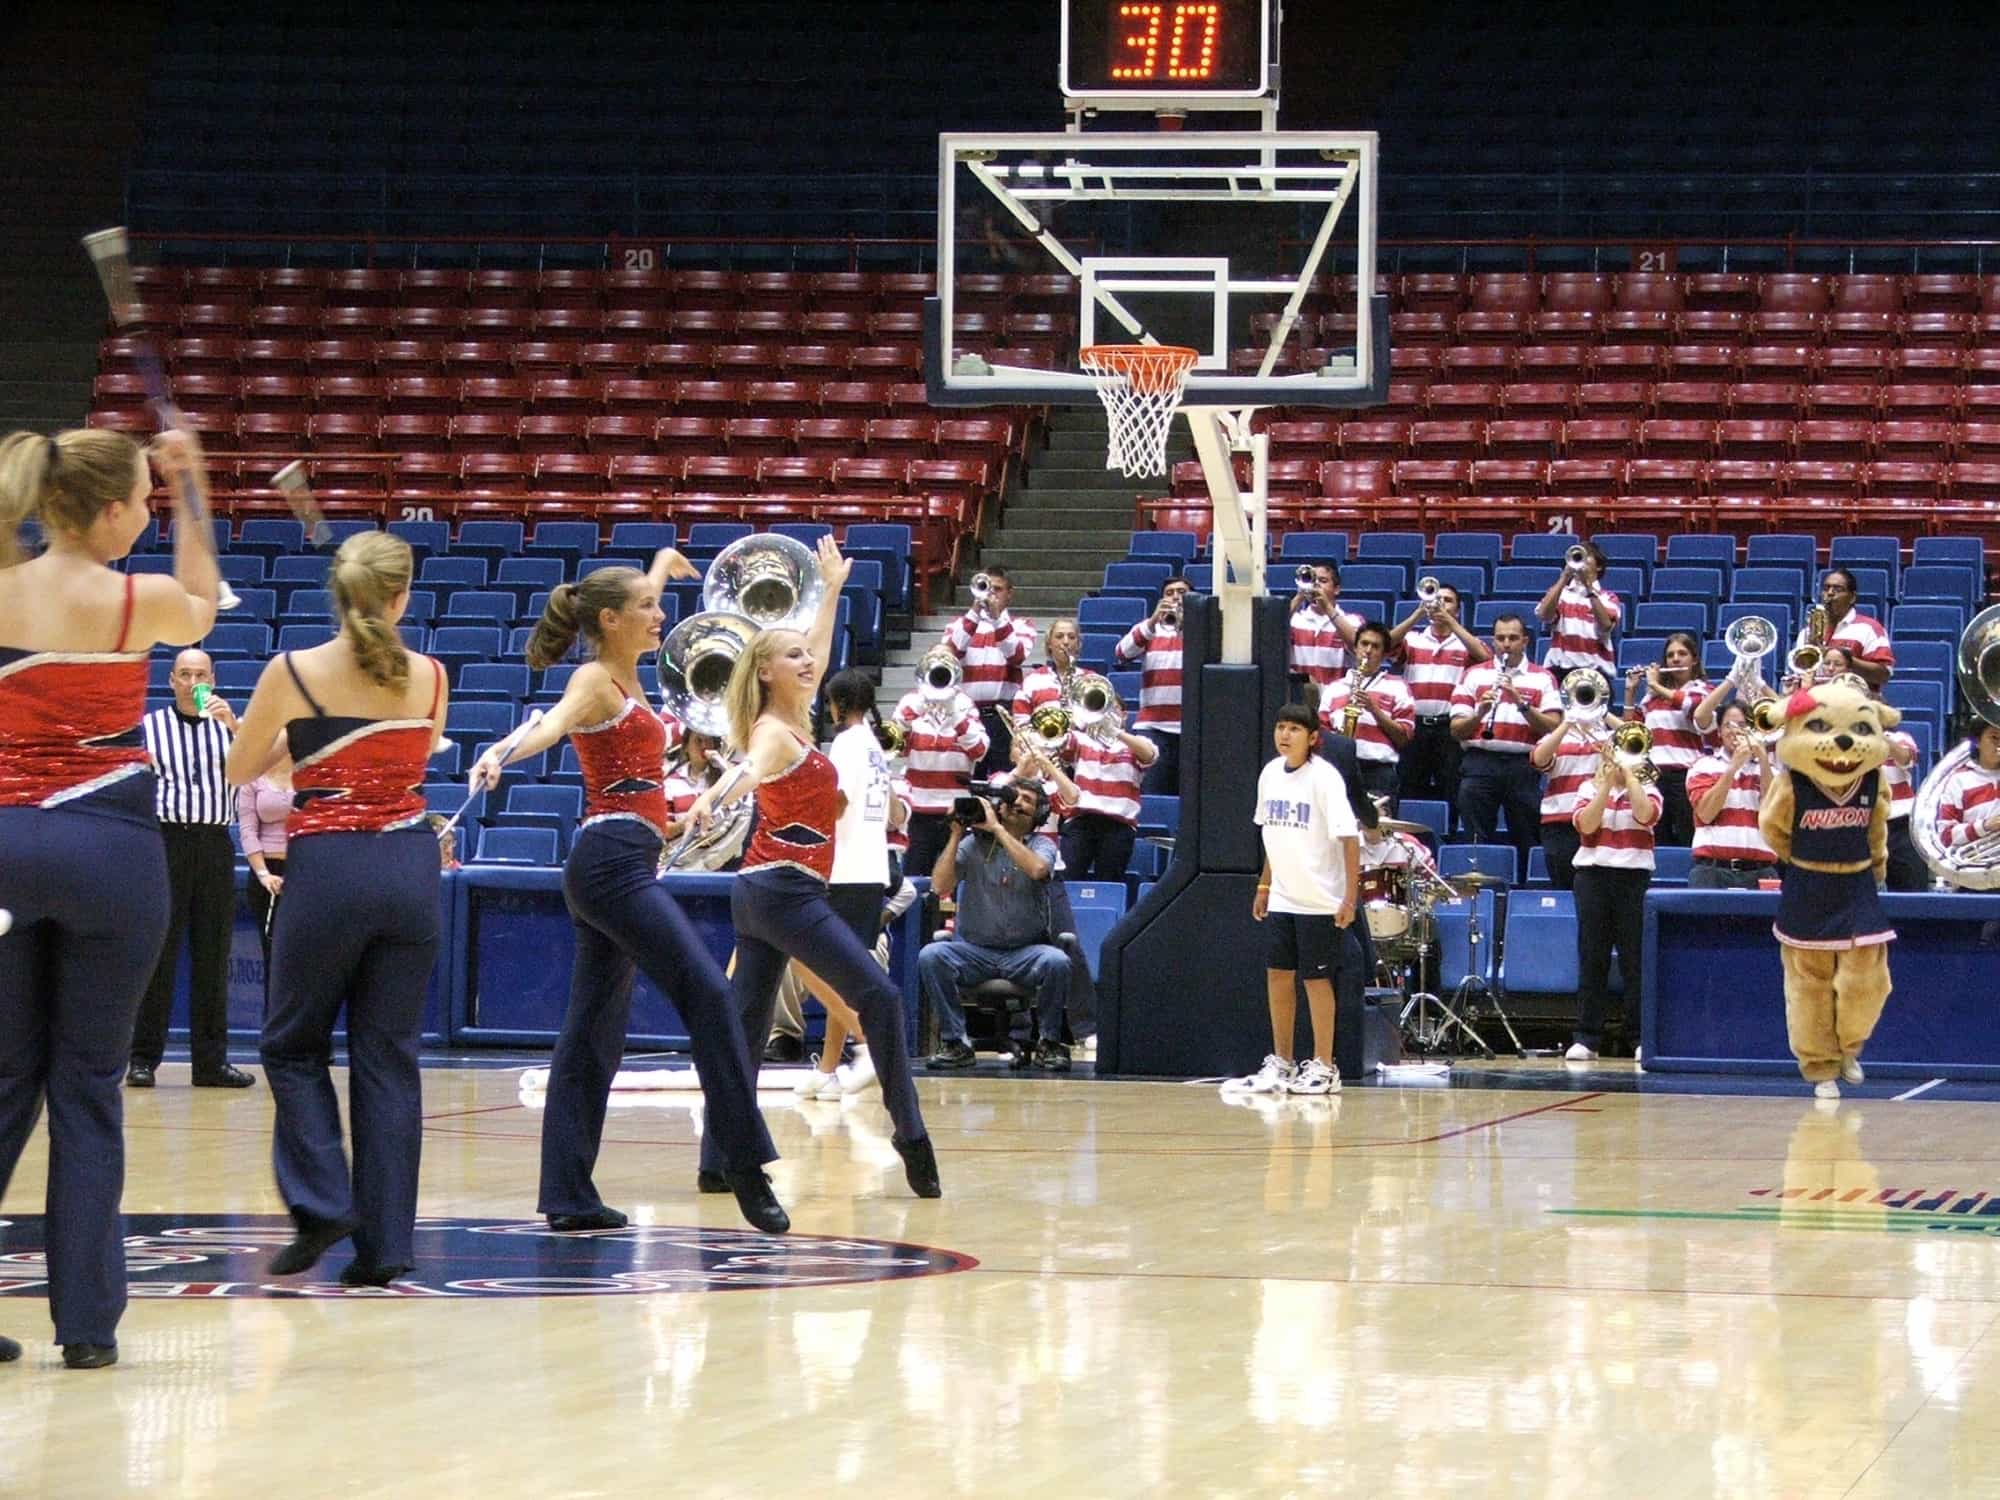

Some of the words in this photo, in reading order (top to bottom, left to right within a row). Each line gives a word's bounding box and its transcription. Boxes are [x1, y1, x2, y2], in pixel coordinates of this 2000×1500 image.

[1112, 5, 1216, 77] 30
[625, 248, 654, 271] 20
[1640, 251, 1665, 271] 21
[401, 506, 433, 522] 20
[1547, 516, 1573, 535] 21
